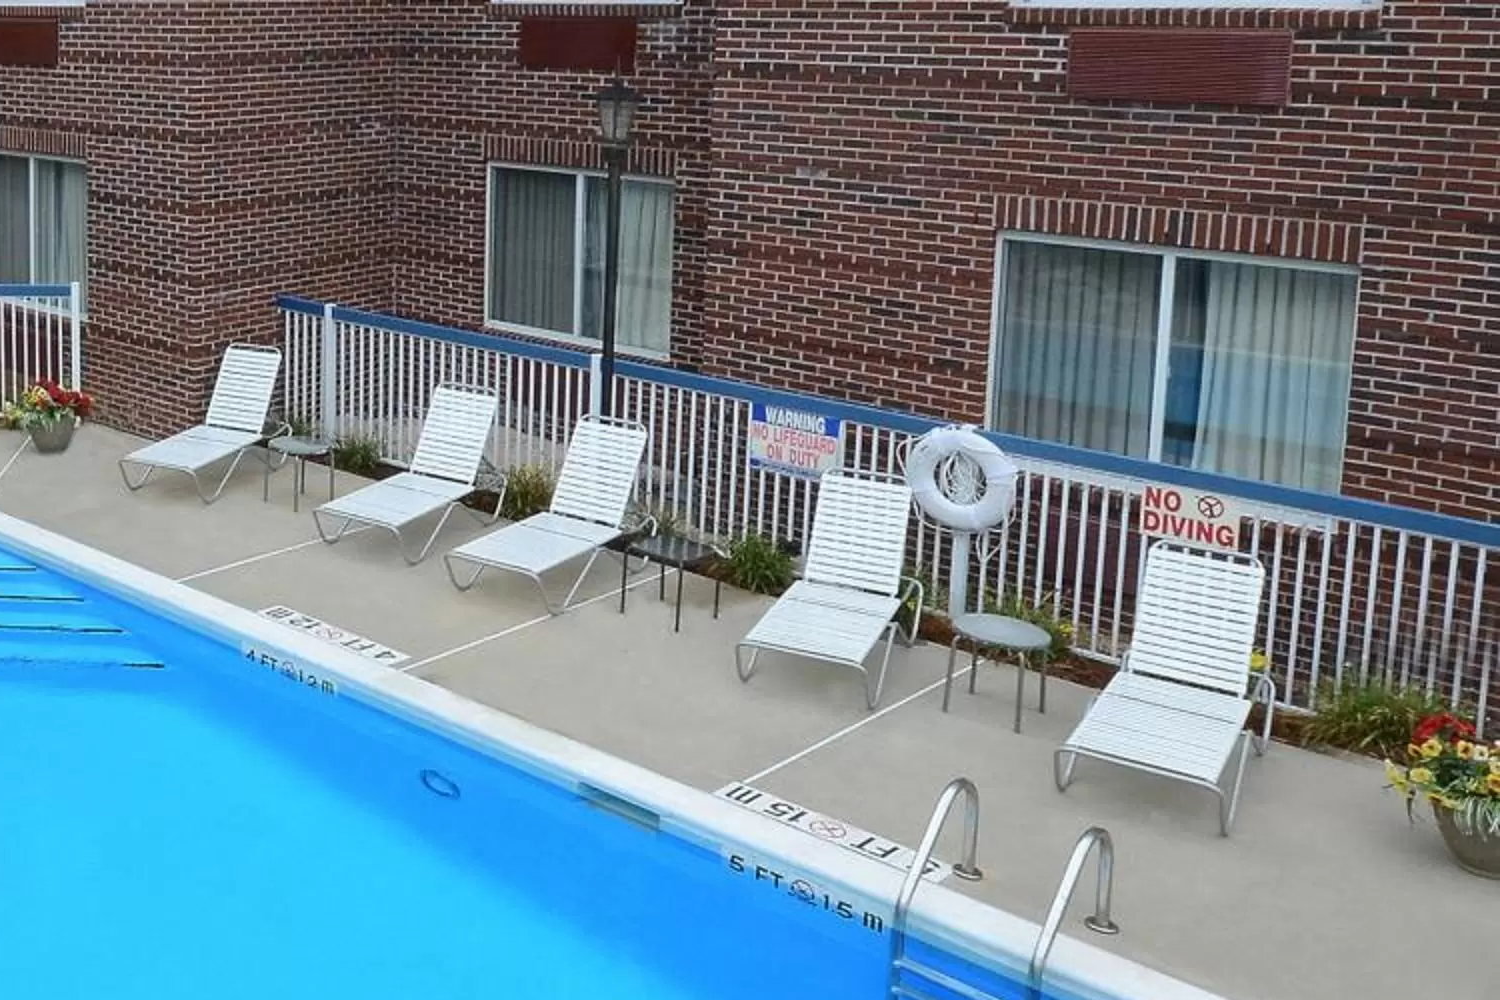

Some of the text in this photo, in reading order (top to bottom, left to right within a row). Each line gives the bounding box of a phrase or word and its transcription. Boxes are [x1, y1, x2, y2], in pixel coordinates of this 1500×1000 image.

[765, 405, 826, 434] WARNING
[750, 423, 836, 454] NO LIFEGUARD
[767, 444, 783, 461] ON
[789, 449, 820, 469] DUTY
[1145, 486, 1182, 512] NO
[1143, 510, 1235, 547] DIVING
[260, 654, 278, 671] FT
[849, 836, 899, 859] FT
[729, 854, 746, 874] 5
[755, 865, 785, 889] FT
[862, 911, 884, 934] m
